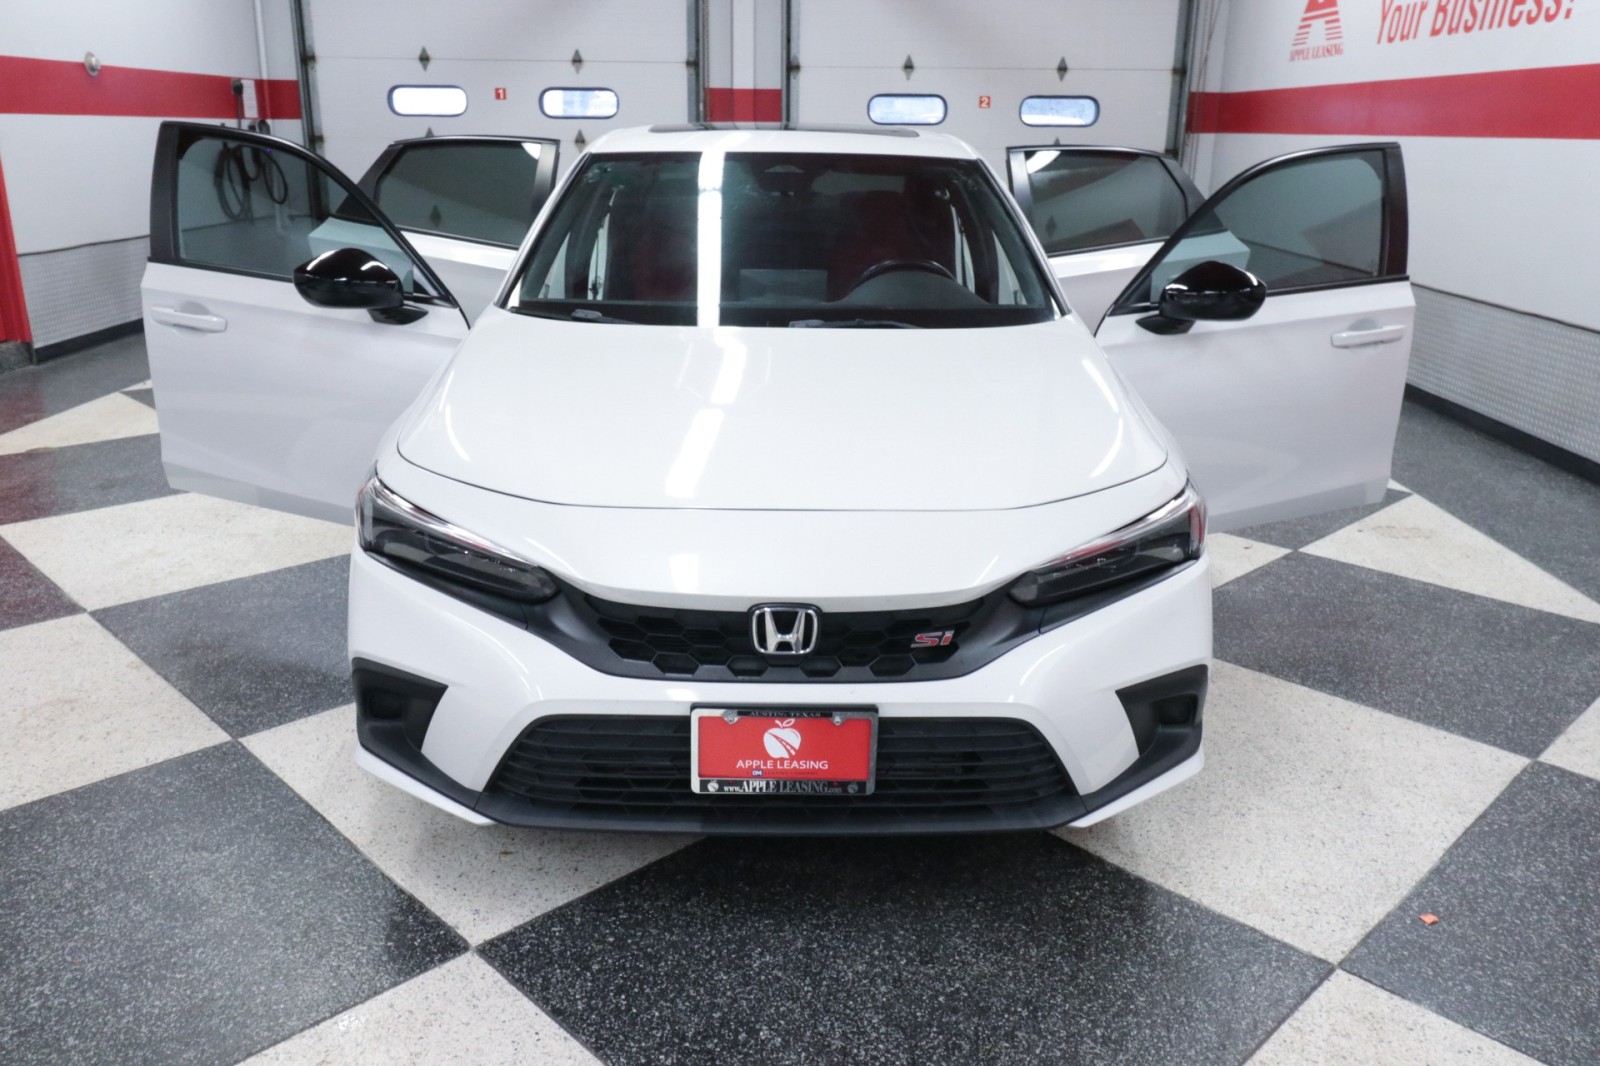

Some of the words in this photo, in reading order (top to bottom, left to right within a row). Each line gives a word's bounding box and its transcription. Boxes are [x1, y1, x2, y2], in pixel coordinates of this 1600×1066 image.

[1377, 0, 1428, 44] Your
[1429, 0, 1574, 37] Business
[980, 96, 989, 108] 2
[911, 629, 955, 648] Si
[736, 759, 774, 769] APPLE
[777, 760, 829, 770] LEASING
